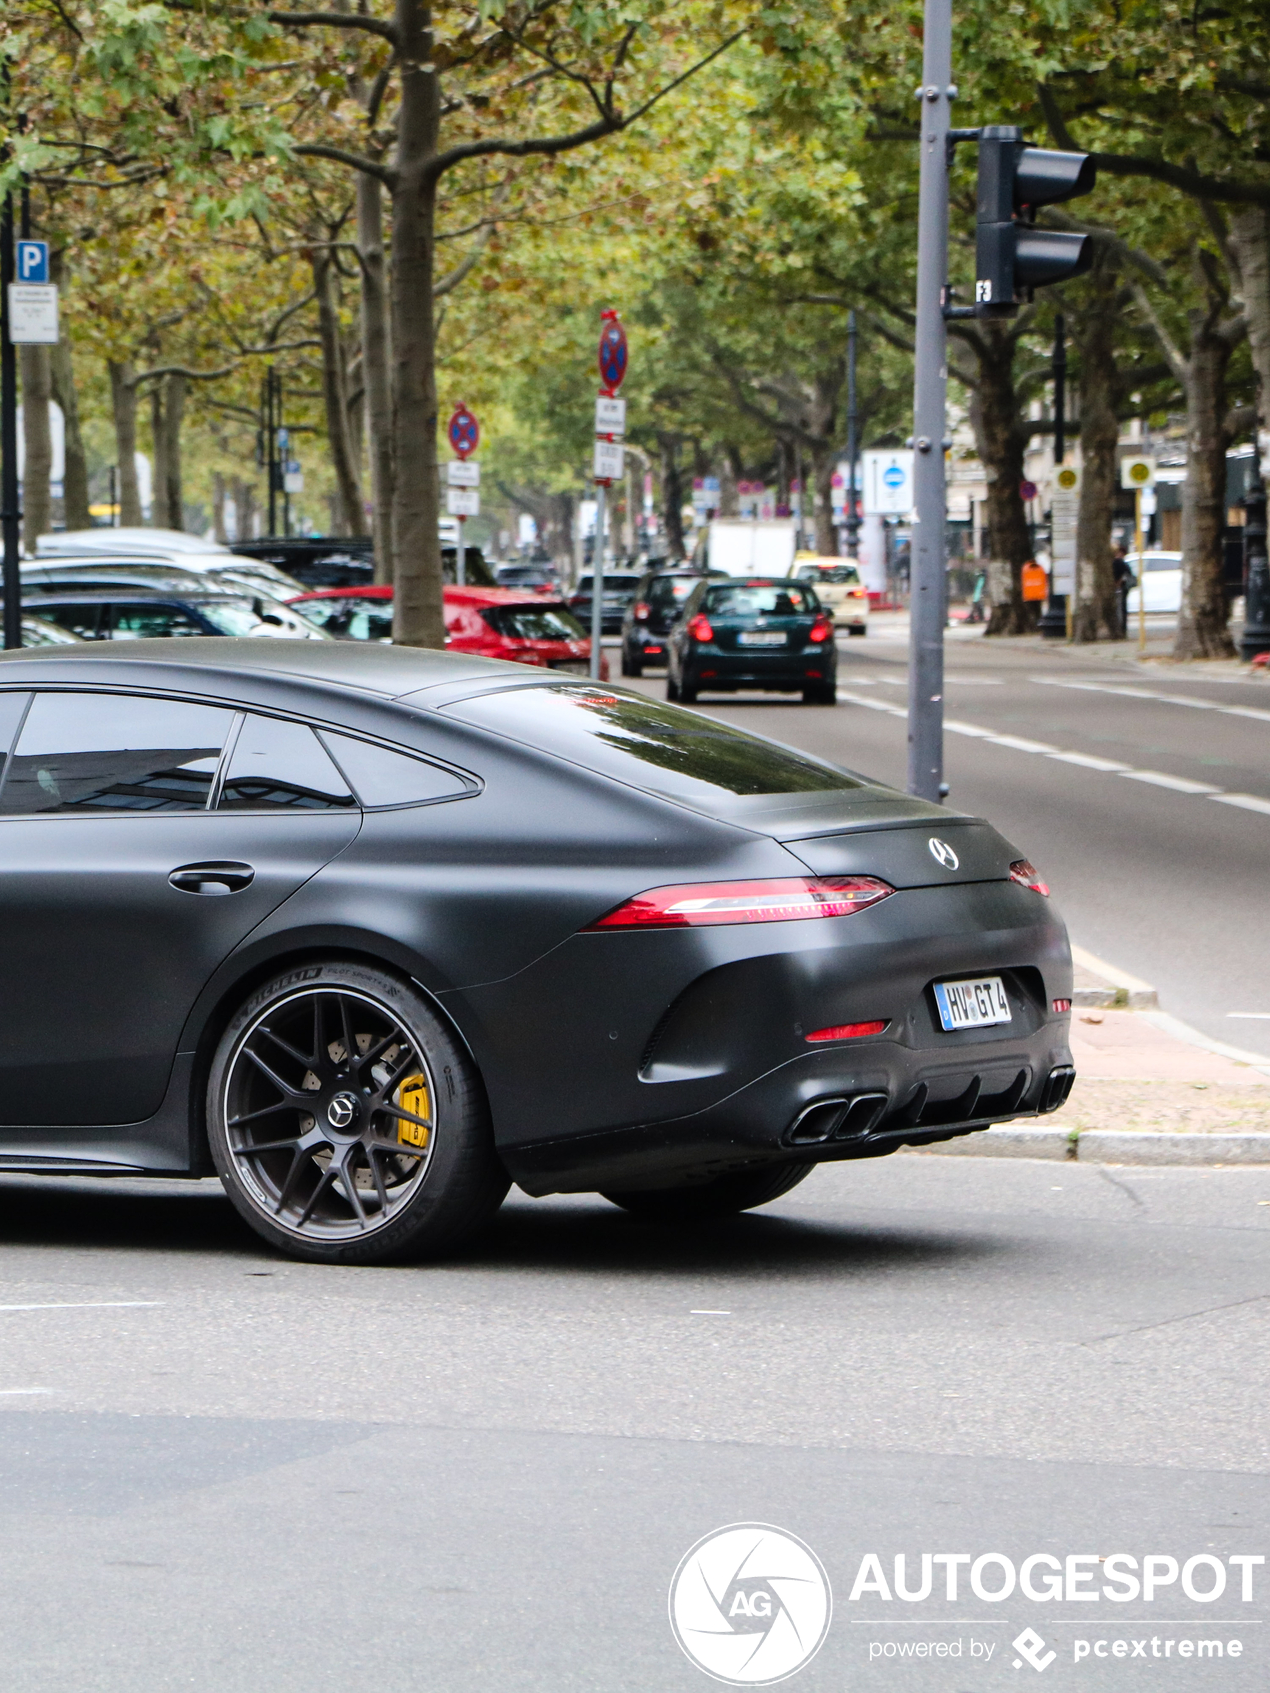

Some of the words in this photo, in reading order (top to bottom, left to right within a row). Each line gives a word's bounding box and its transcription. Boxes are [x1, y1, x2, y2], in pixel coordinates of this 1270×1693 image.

[23, 245, 42, 278] P
[975, 279, 992, 303] F3
[247, 967, 318, 1014] MICHELIN
[946, 986, 970, 1022] HV
[974, 983, 996, 1019] GT
[996, 982, 1008, 1016] 4
